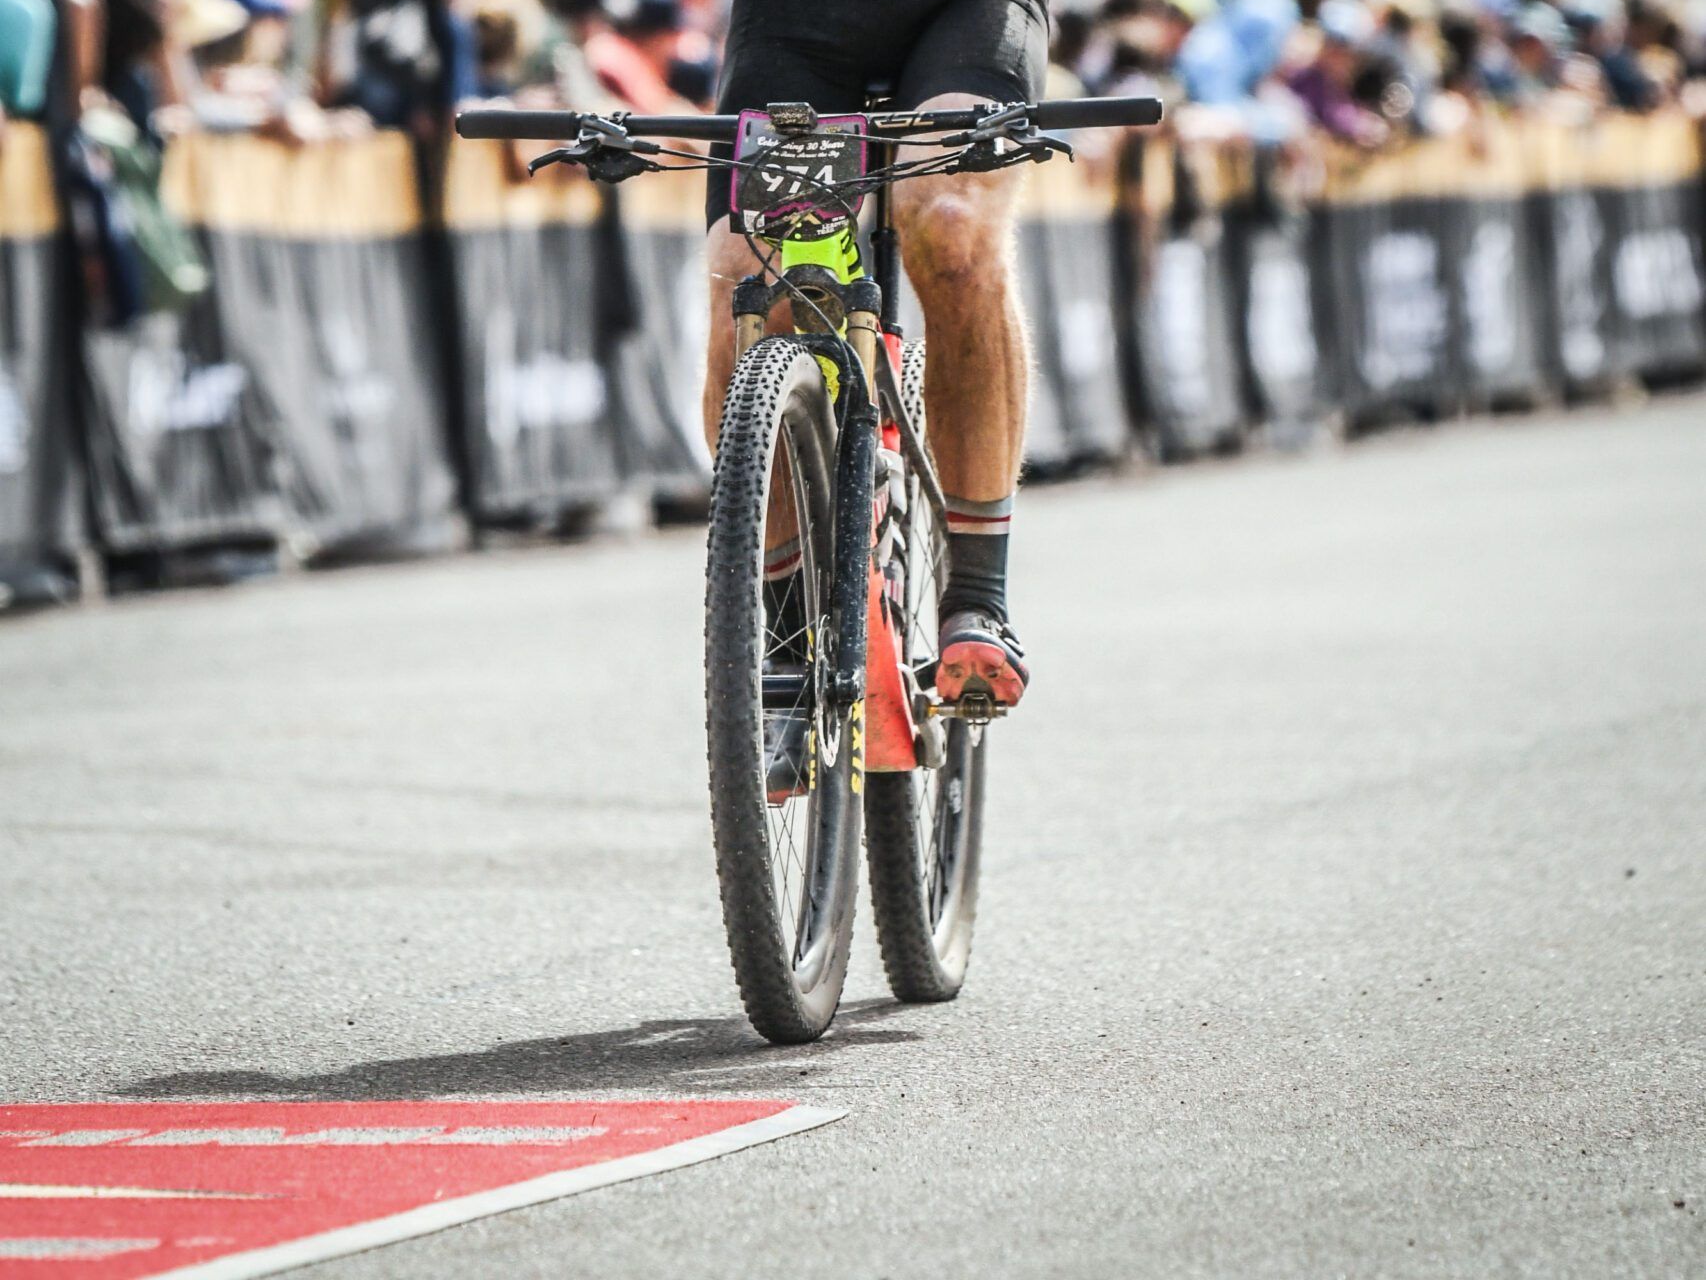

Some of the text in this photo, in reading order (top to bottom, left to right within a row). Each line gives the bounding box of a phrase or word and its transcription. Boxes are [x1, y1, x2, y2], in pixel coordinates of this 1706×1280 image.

[806, 141, 819, 151] 30
[819, 139, 846, 151] Years
[761, 163, 836, 194] 974
